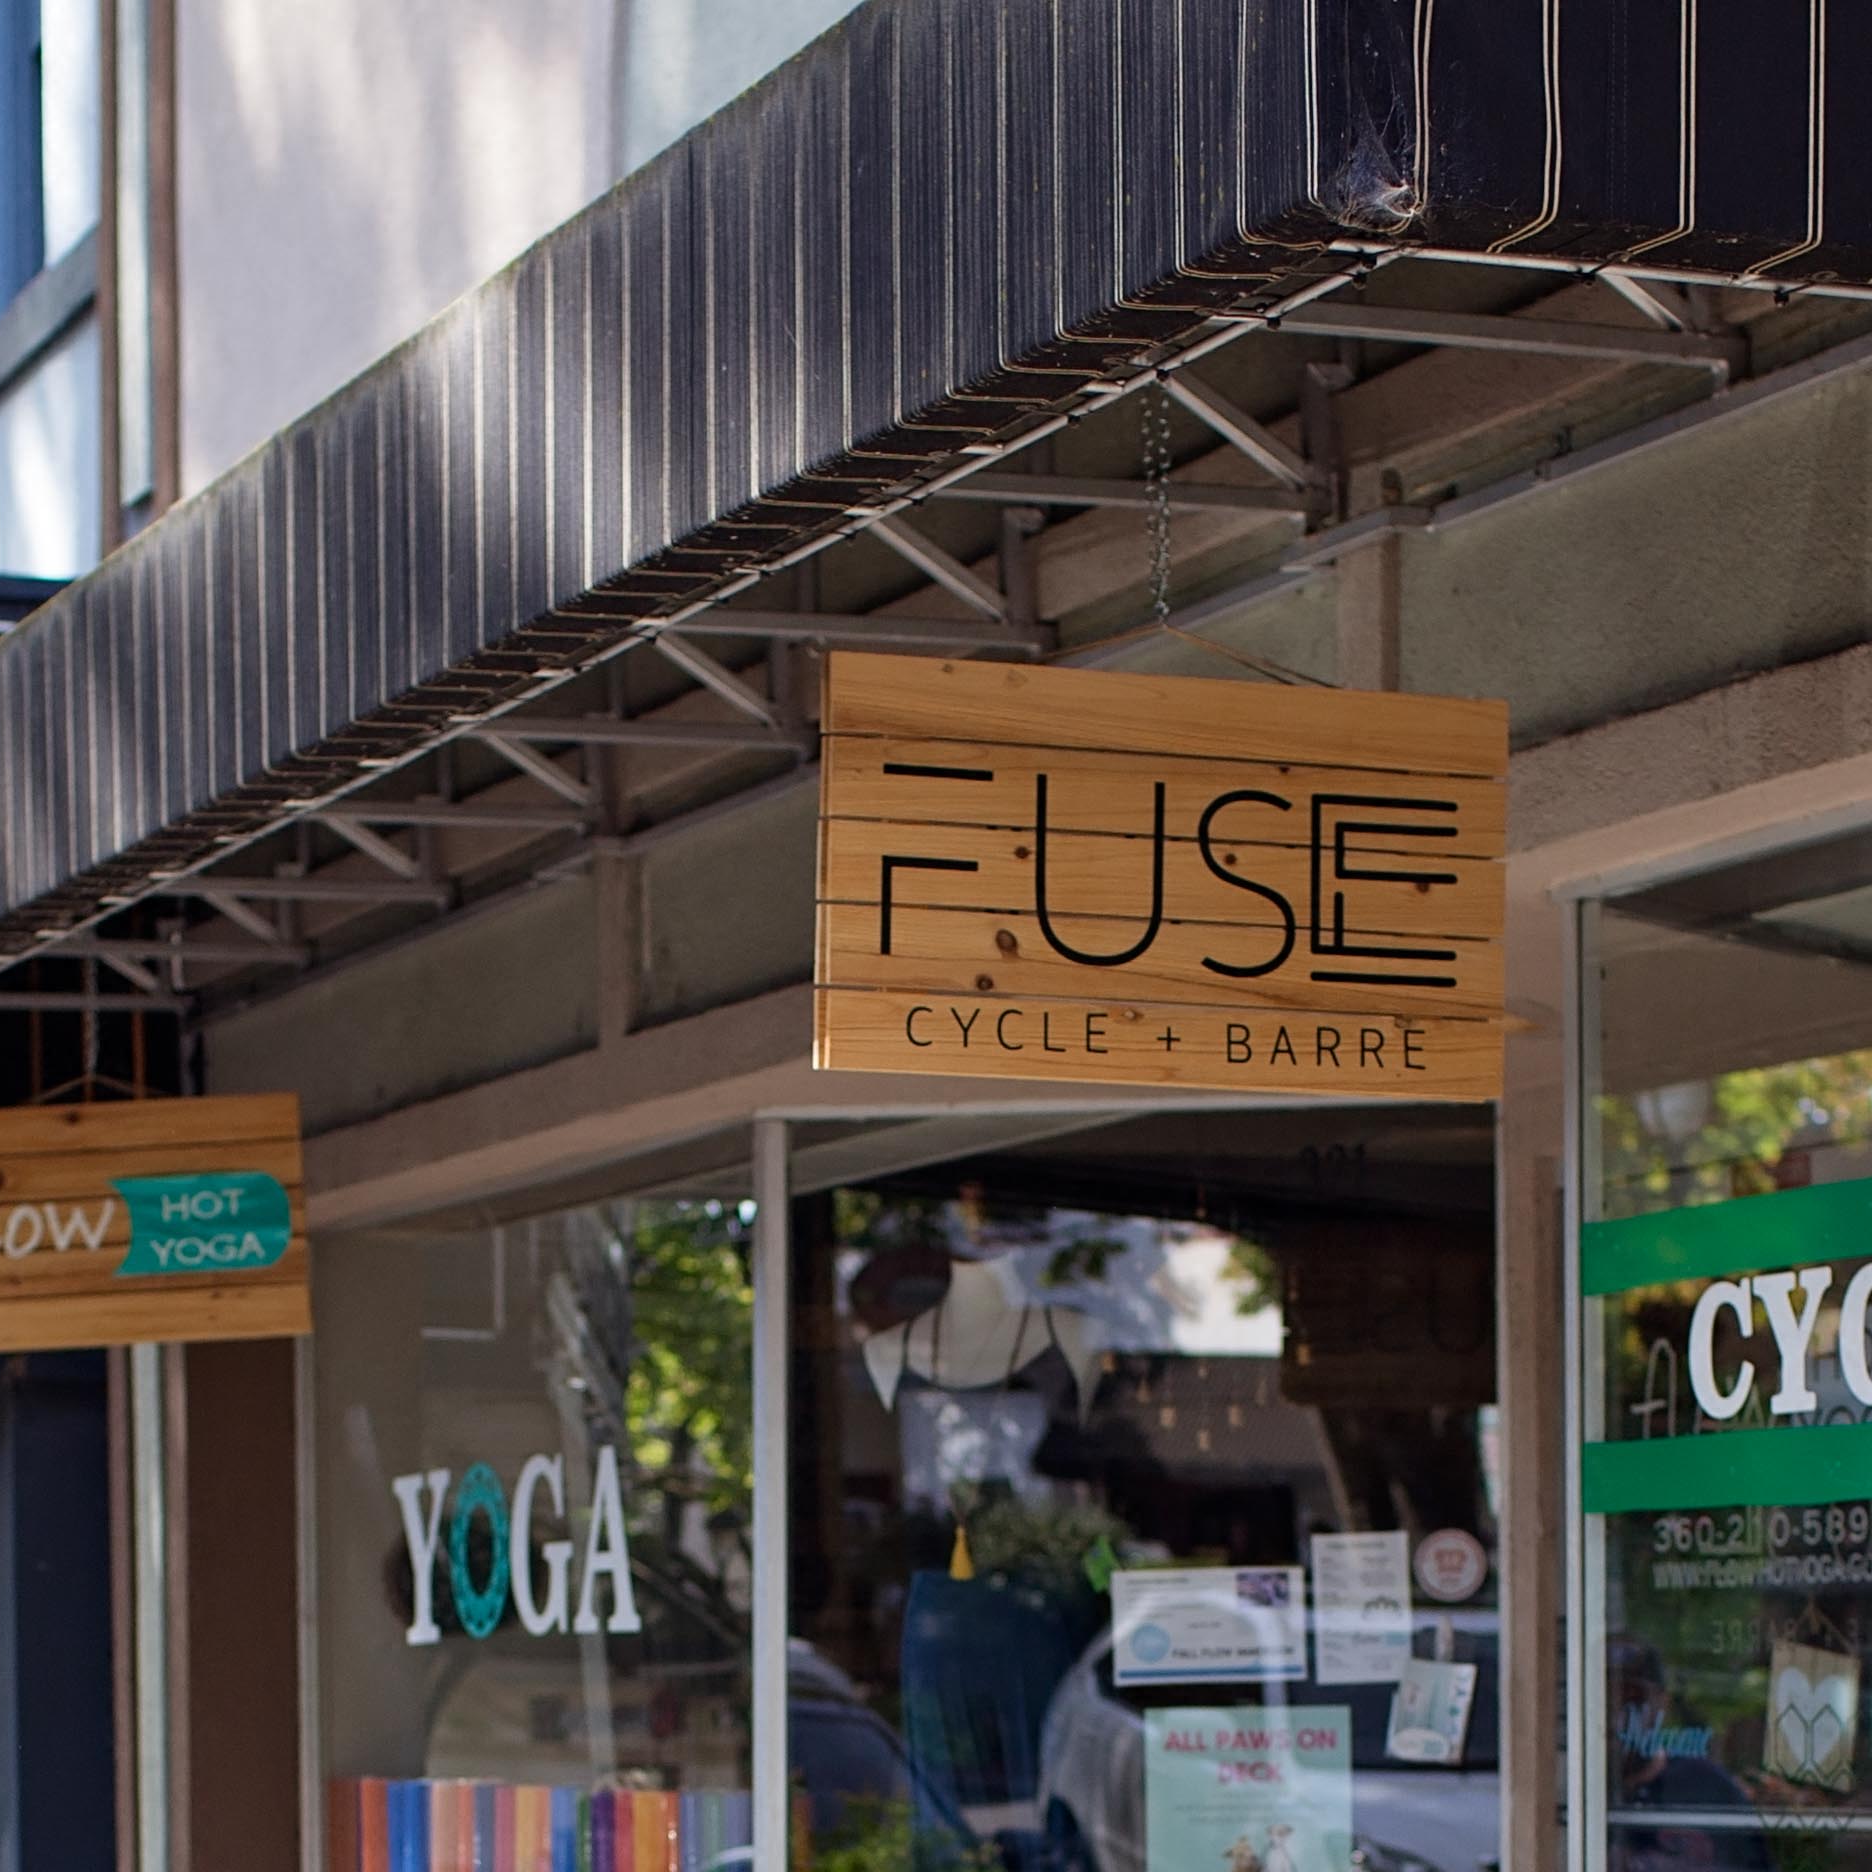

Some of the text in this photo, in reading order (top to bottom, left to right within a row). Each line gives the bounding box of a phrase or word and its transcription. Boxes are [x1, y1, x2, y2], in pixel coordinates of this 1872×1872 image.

[882, 763, 1458, 988] FUSE
[904, 1005, 1110, 1055] CYCLE
[1225, 1023, 1428, 1071] BARRE
[161, 1188, 246, 1223] HOT
[150, 1232, 266, 1267] YOGA
[391, 1444, 643, 1647] YOGA
[1163, 1726, 1338, 1752] ALL PAWS ON
